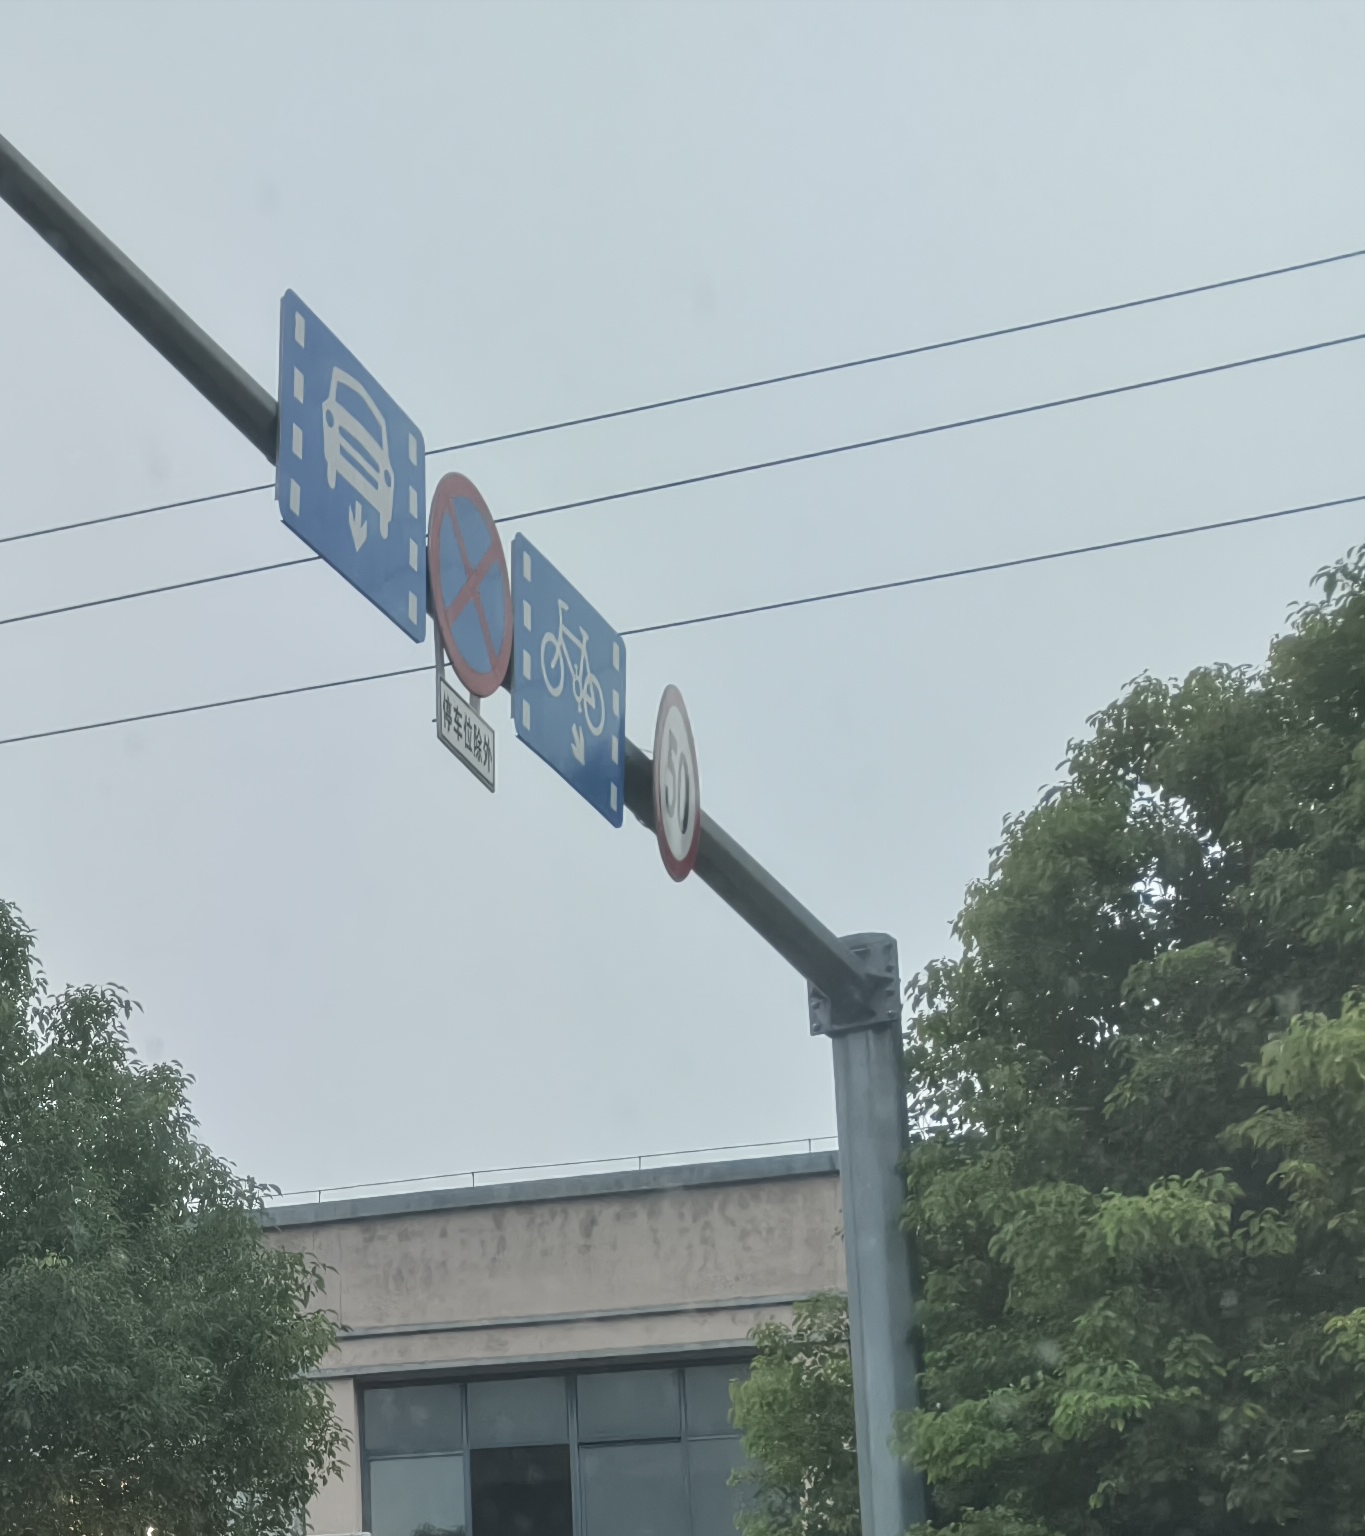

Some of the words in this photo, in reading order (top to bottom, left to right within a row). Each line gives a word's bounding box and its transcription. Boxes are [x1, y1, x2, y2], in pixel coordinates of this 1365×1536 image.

[442, 690, 493, 773] 停车位除外
[665, 728, 690, 834] 50
